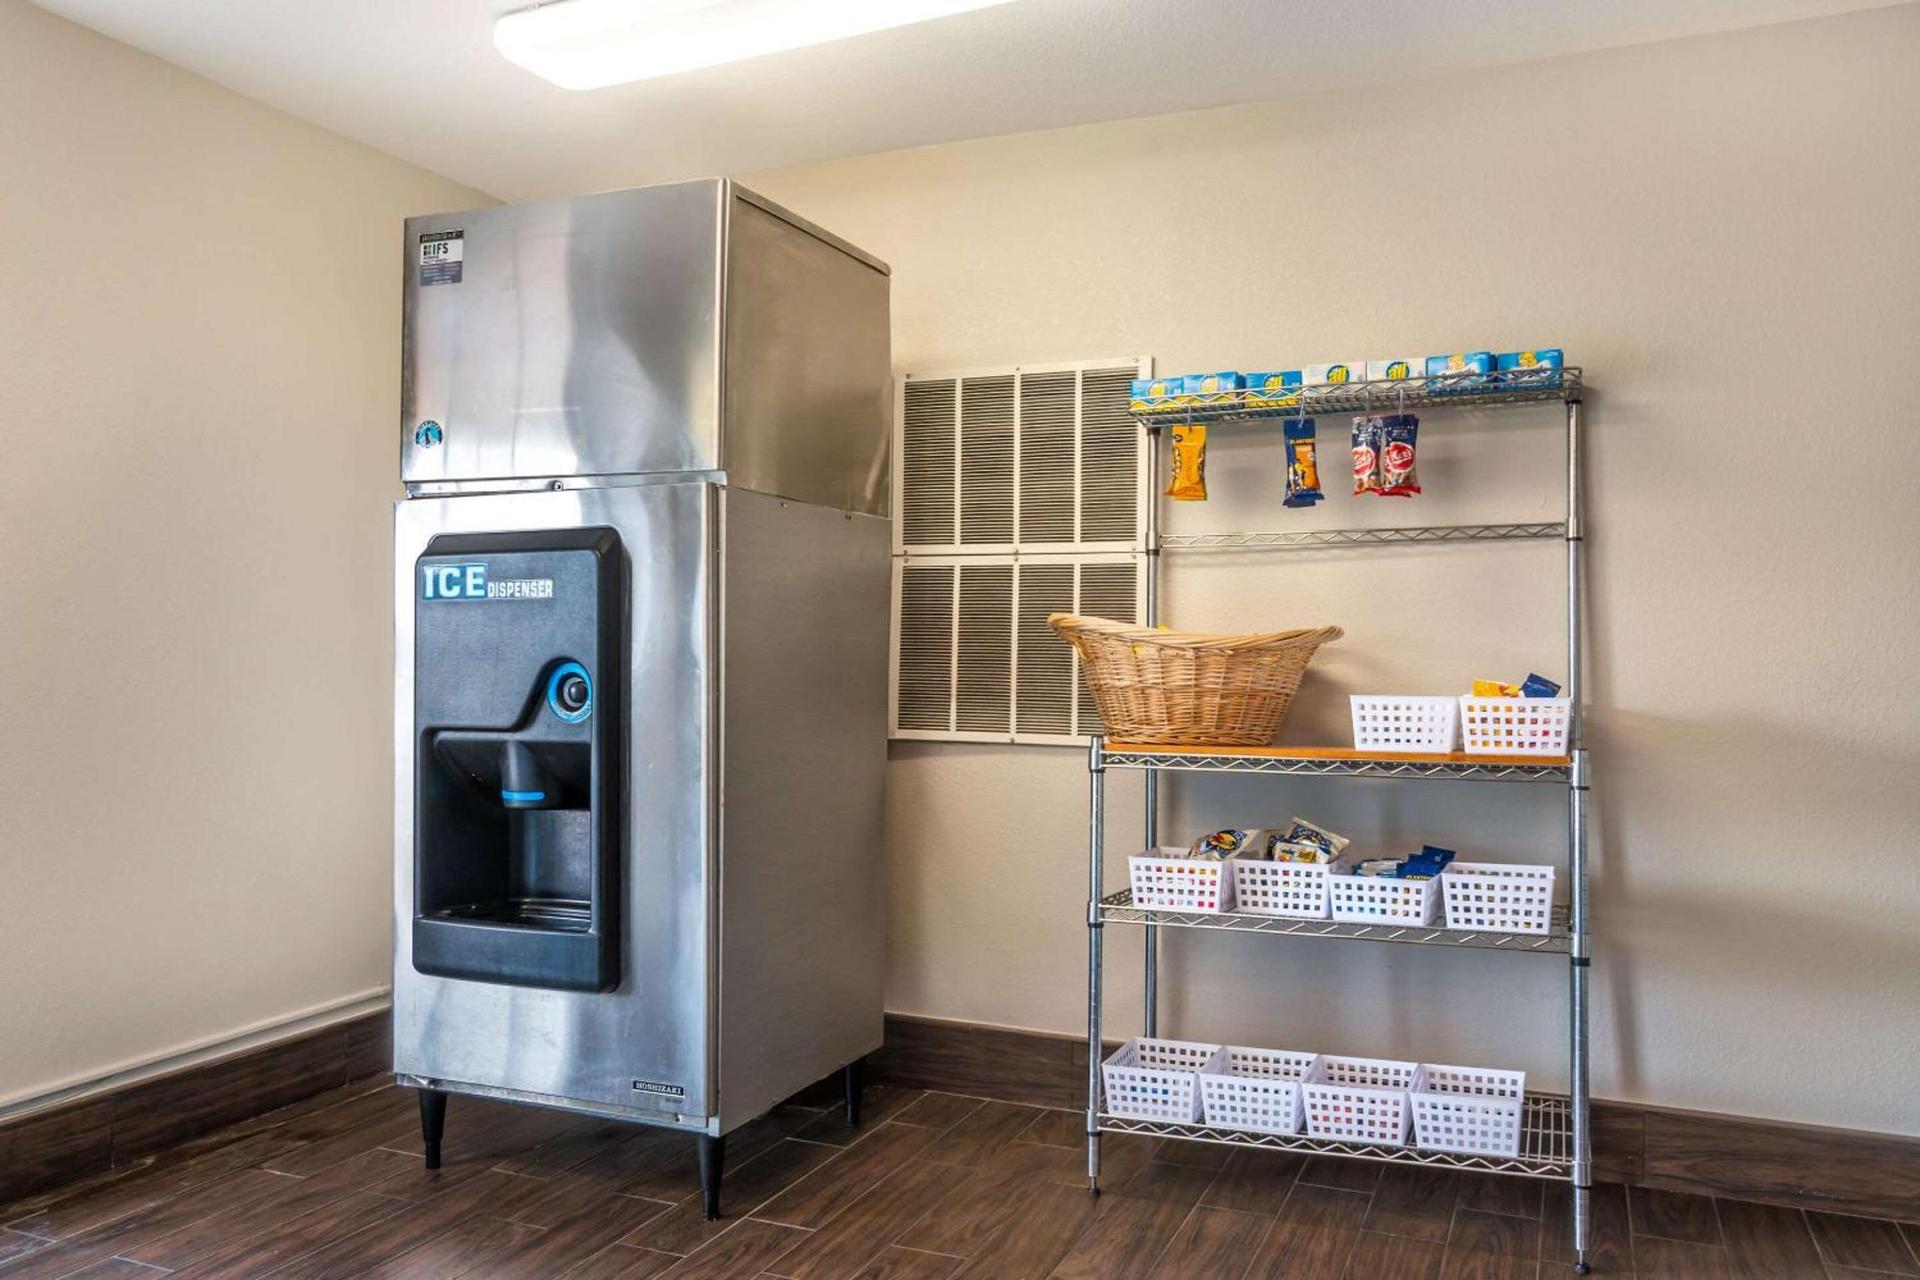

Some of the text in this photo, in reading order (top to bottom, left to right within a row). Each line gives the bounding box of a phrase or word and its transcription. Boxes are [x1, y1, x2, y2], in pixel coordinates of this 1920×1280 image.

[433, 242, 449, 256] IFS
[1328, 367, 1347, 384] all
[1387, 363, 1406, 380] all
[424, 566, 554, 598] ICE DISPENSER
